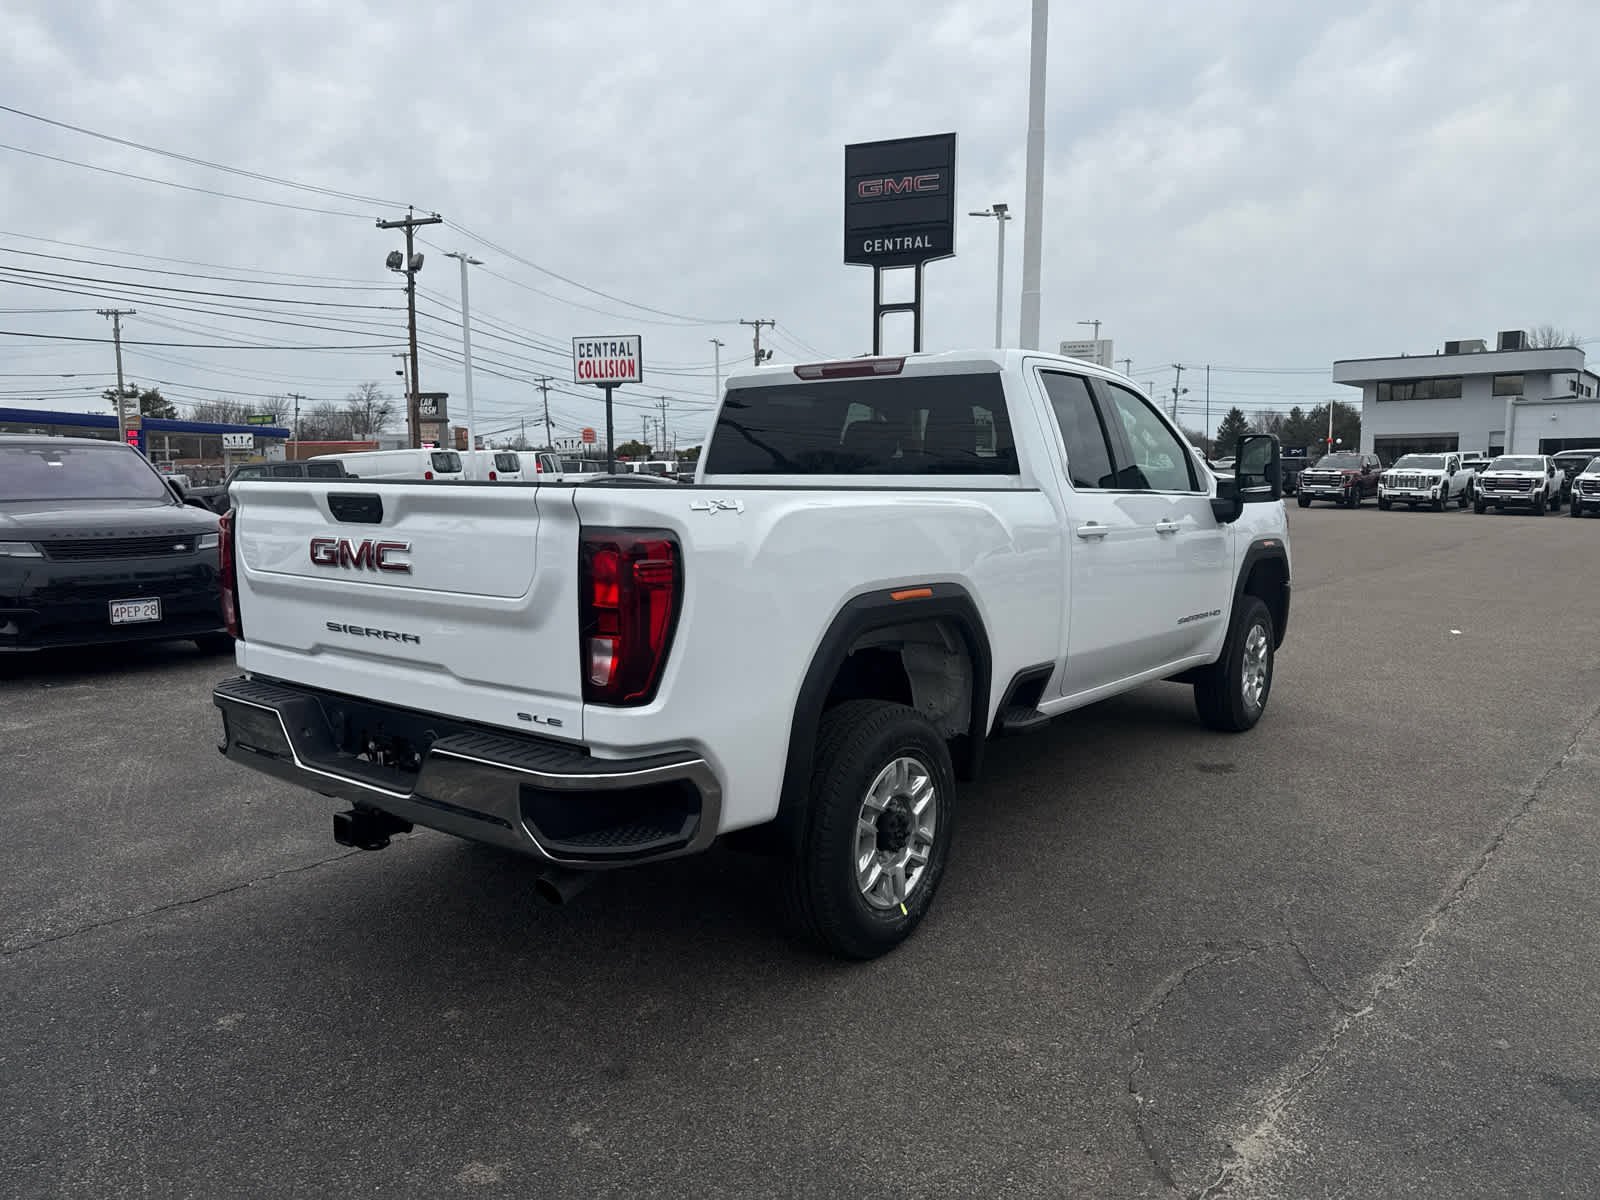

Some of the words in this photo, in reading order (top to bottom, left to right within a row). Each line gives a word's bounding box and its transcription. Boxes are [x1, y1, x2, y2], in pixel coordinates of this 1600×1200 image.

[858, 174, 939, 197] GMC
[863, 235, 933, 253] CENTRAL
[578, 342, 633, 358] CENTRAL
[578, 359, 635, 379] COLLISION
[310, 536, 412, 575] GMC
[113, 606, 141, 618] 4PEP
[143, 604, 157, 616] 28
[325, 620, 421, 644] SIERRA
[517, 711, 564, 727] SLE
